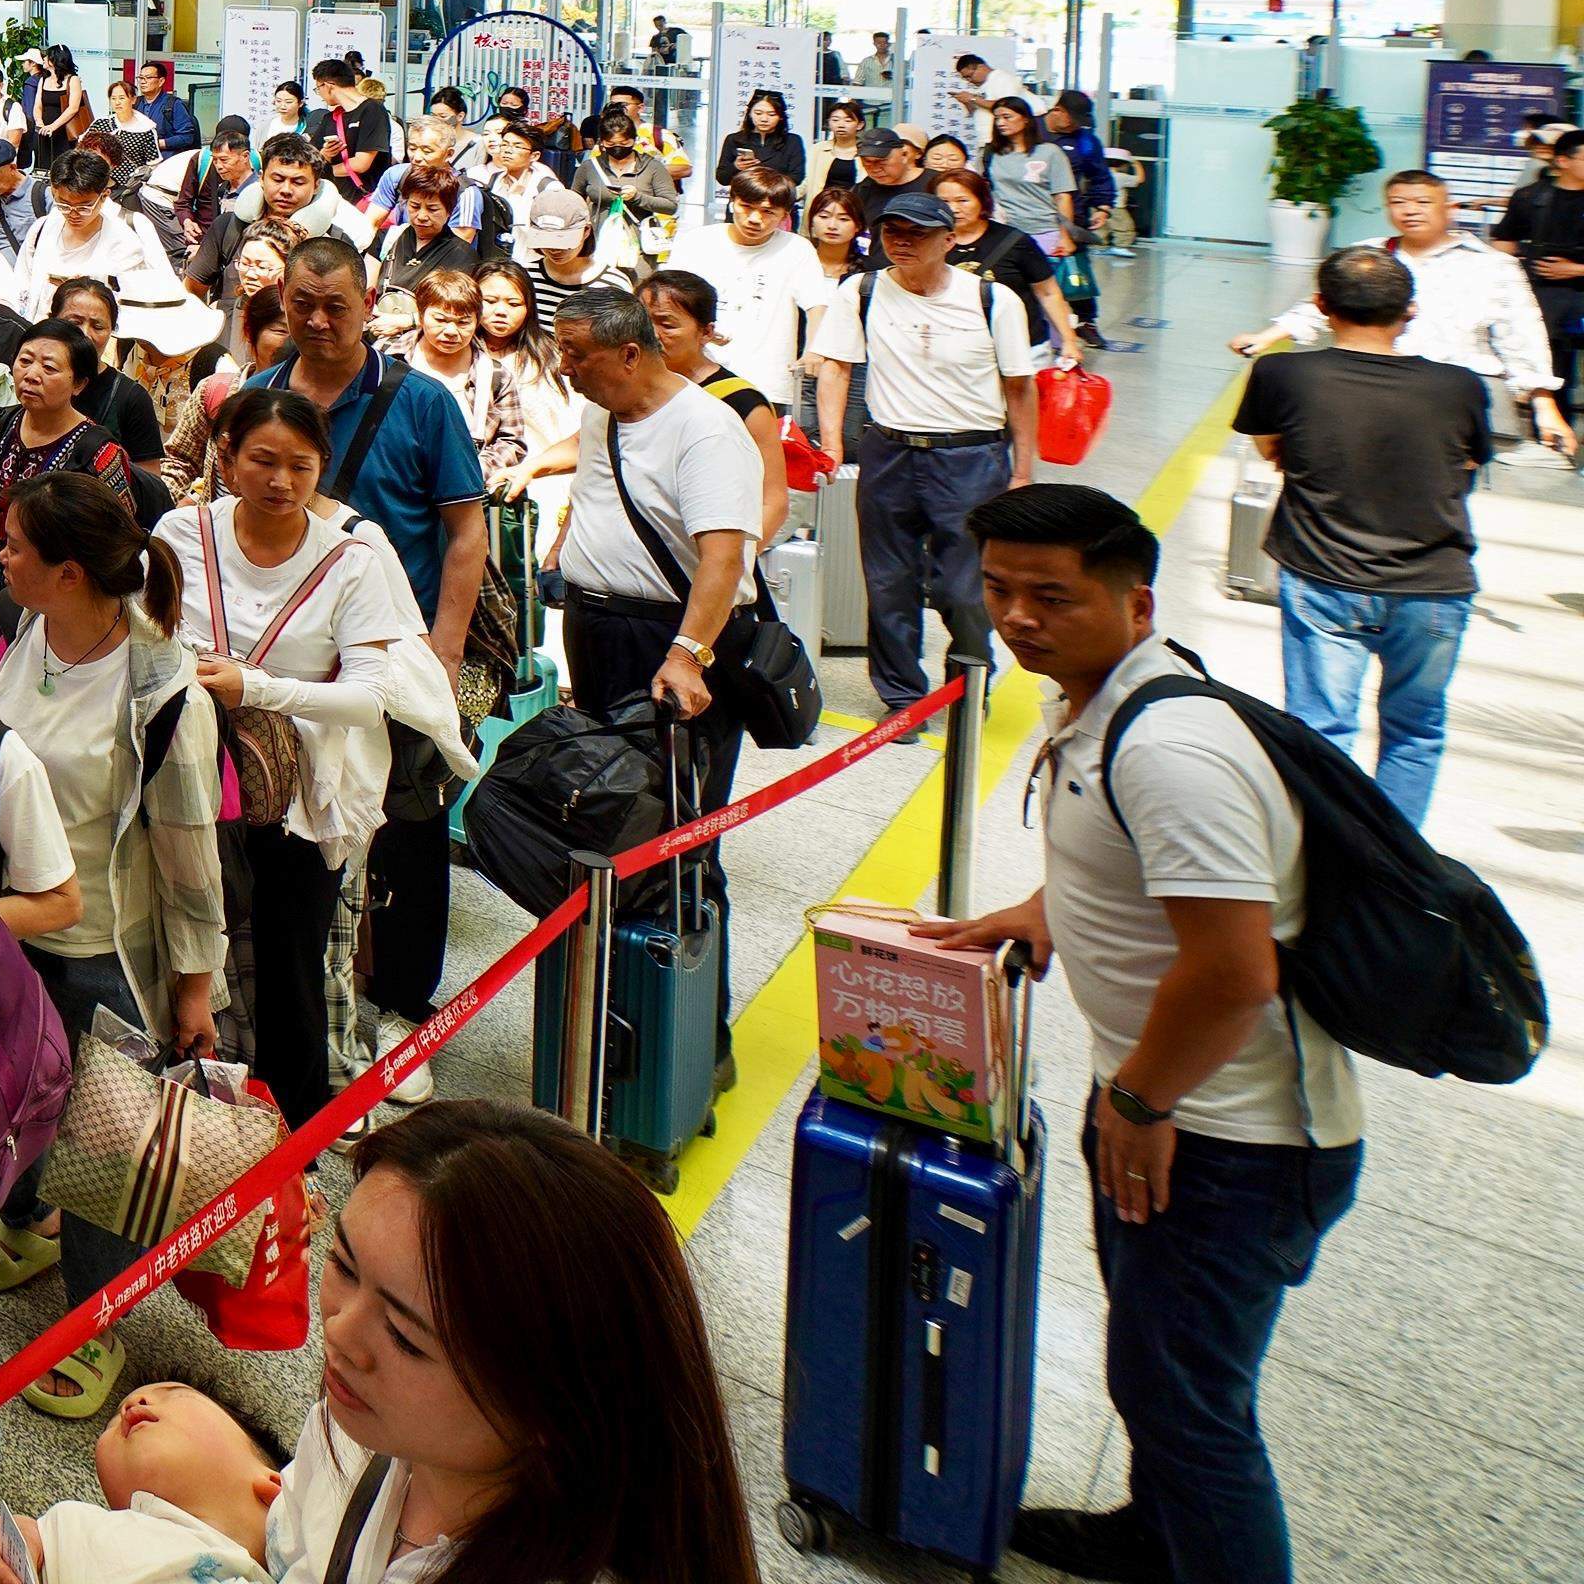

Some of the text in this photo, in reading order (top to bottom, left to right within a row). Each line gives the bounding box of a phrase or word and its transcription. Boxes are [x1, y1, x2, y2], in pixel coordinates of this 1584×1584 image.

[522, 61, 543, 70] 富强
[830, 960, 967, 1013] 心花怒放
[419, 988, 480, 1051] 中老铁路欢迎您
[832, 988, 968, 1049] 万物有爱
[114, 1192, 239, 1310] 中老铁路 中老铁路欢迎您
